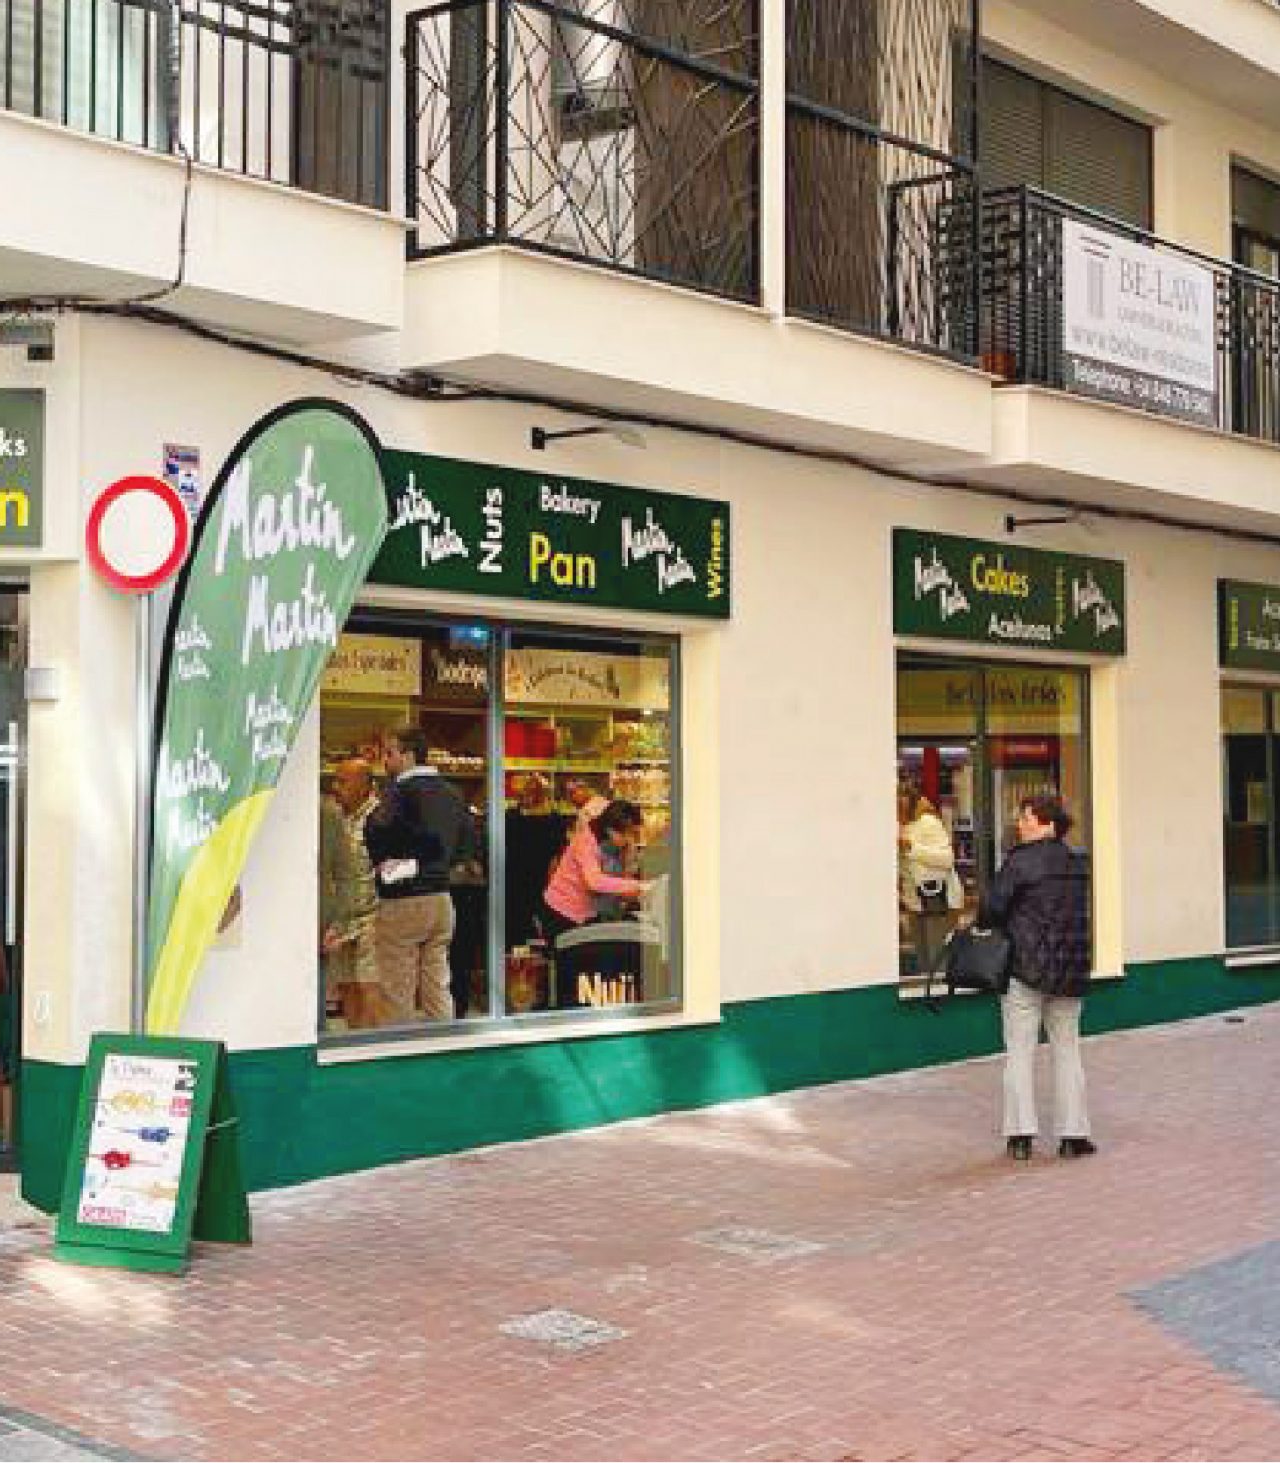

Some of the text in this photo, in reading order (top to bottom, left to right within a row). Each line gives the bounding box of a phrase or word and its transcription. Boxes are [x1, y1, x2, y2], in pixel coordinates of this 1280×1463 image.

[214, 445, 355, 576] Martín
[477, 487, 503, 573] Nuts
[540, 484, 602, 524] Bakery
[529, 531, 597, 589] Pan
[707, 518, 723, 599] Wines
[972, 553, 1029, 598] Cakes
[241, 563, 337, 666] Martín
